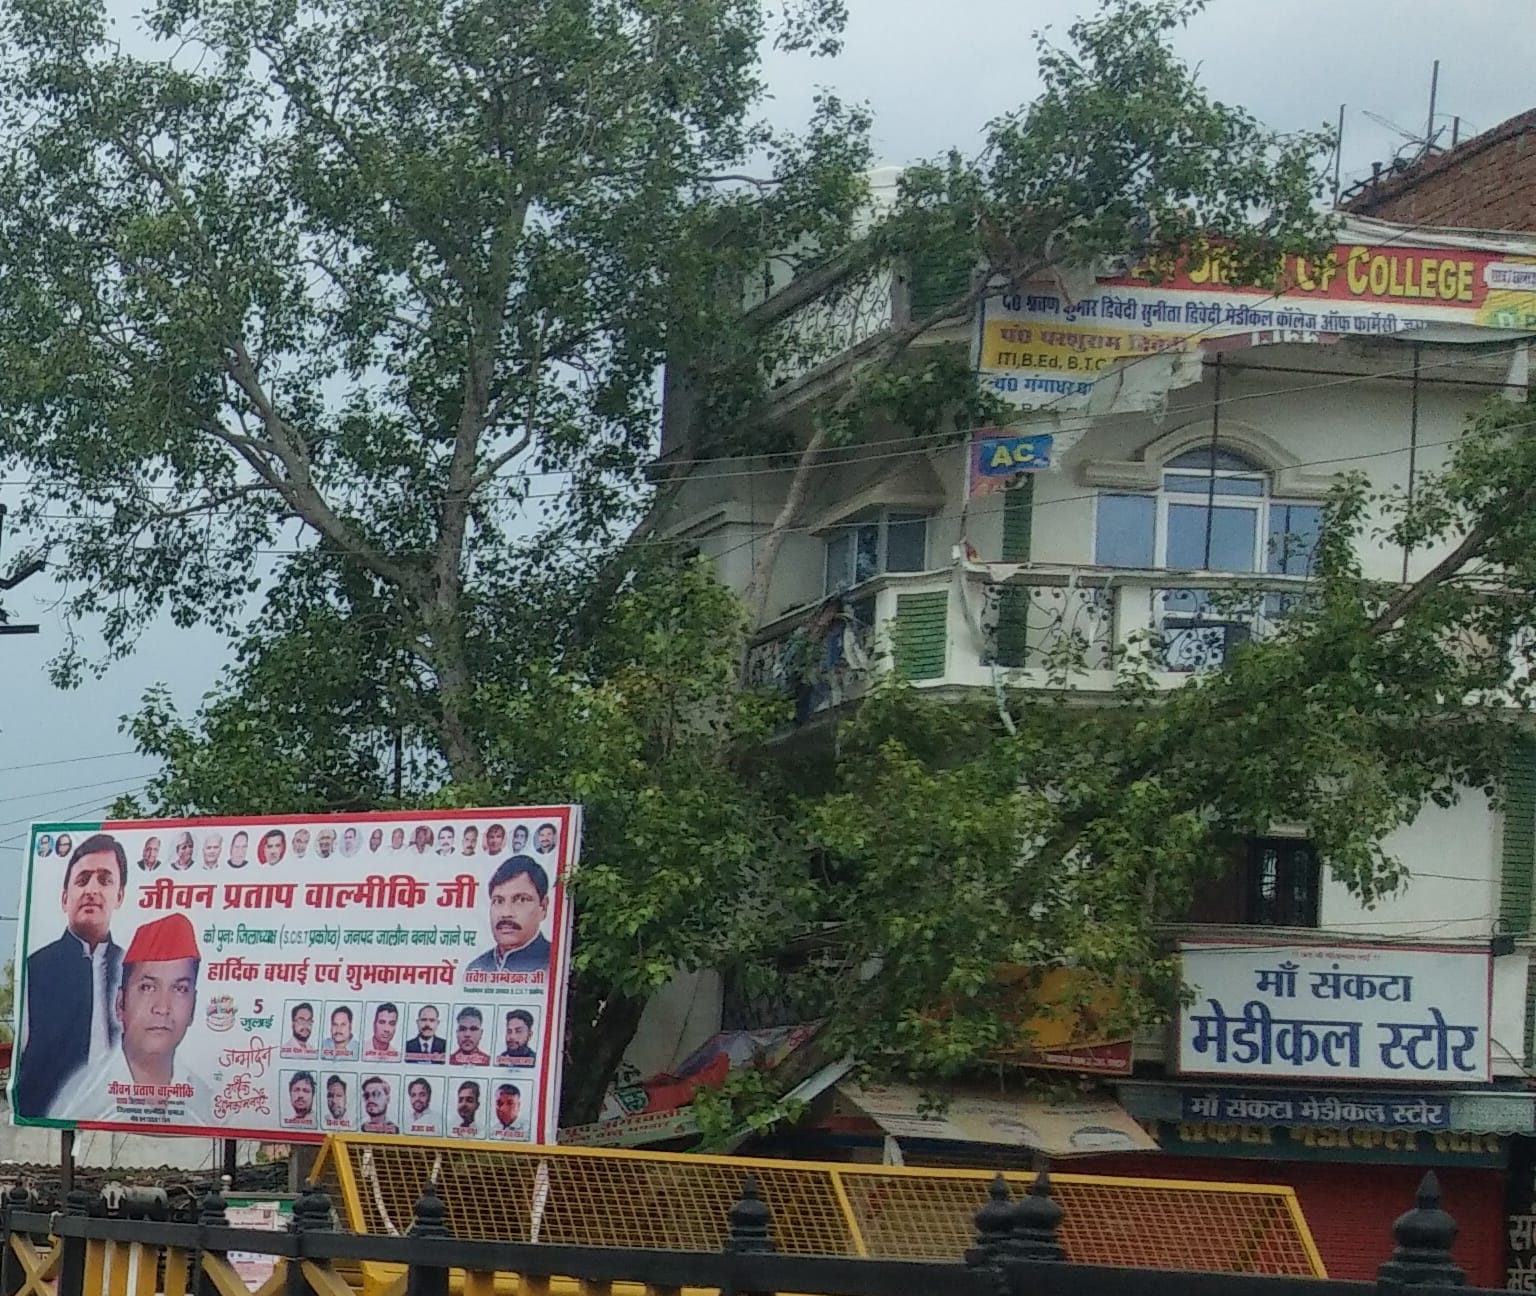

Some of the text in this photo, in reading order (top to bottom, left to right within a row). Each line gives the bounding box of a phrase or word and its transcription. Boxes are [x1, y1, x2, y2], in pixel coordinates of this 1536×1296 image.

[1347, 246, 1474, 301] COLLEGE
[1142, 300, 1179, 327] सुनीता
[1184, 302, 1222, 325] द्विवेदी
[991, 443, 1035, 467] AC
[138, 874, 479, 911] जीवन प्रताप वाल्मीकि जी
[203, 924, 216, 944] को
[343, 928, 374, 946] जनपद
[376, 924, 410, 946] जालौन
[411, 924, 437, 946] बनाये
[439, 924, 461, 946] जाने
[463, 929, 478, 947] पर
[207, 956, 459, 991] हार्दिक बधाई एवं शुभकामनायें
[530, 968, 545, 984] जी
[1255, 960, 1413, 1002] माँ संकटा
[253, 998, 264, 1014] 5
[240, 1015, 274, 1032] जुलाई
[1190, 999, 1479, 1073] मेडीकल स्टोर
[108, 1081, 194, 1098] जीवन प्रताप वाल्मीकि
[1299, 1096, 1386, 1123] मेडीकल
[1391, 1098, 1445, 1125] स्टोर
